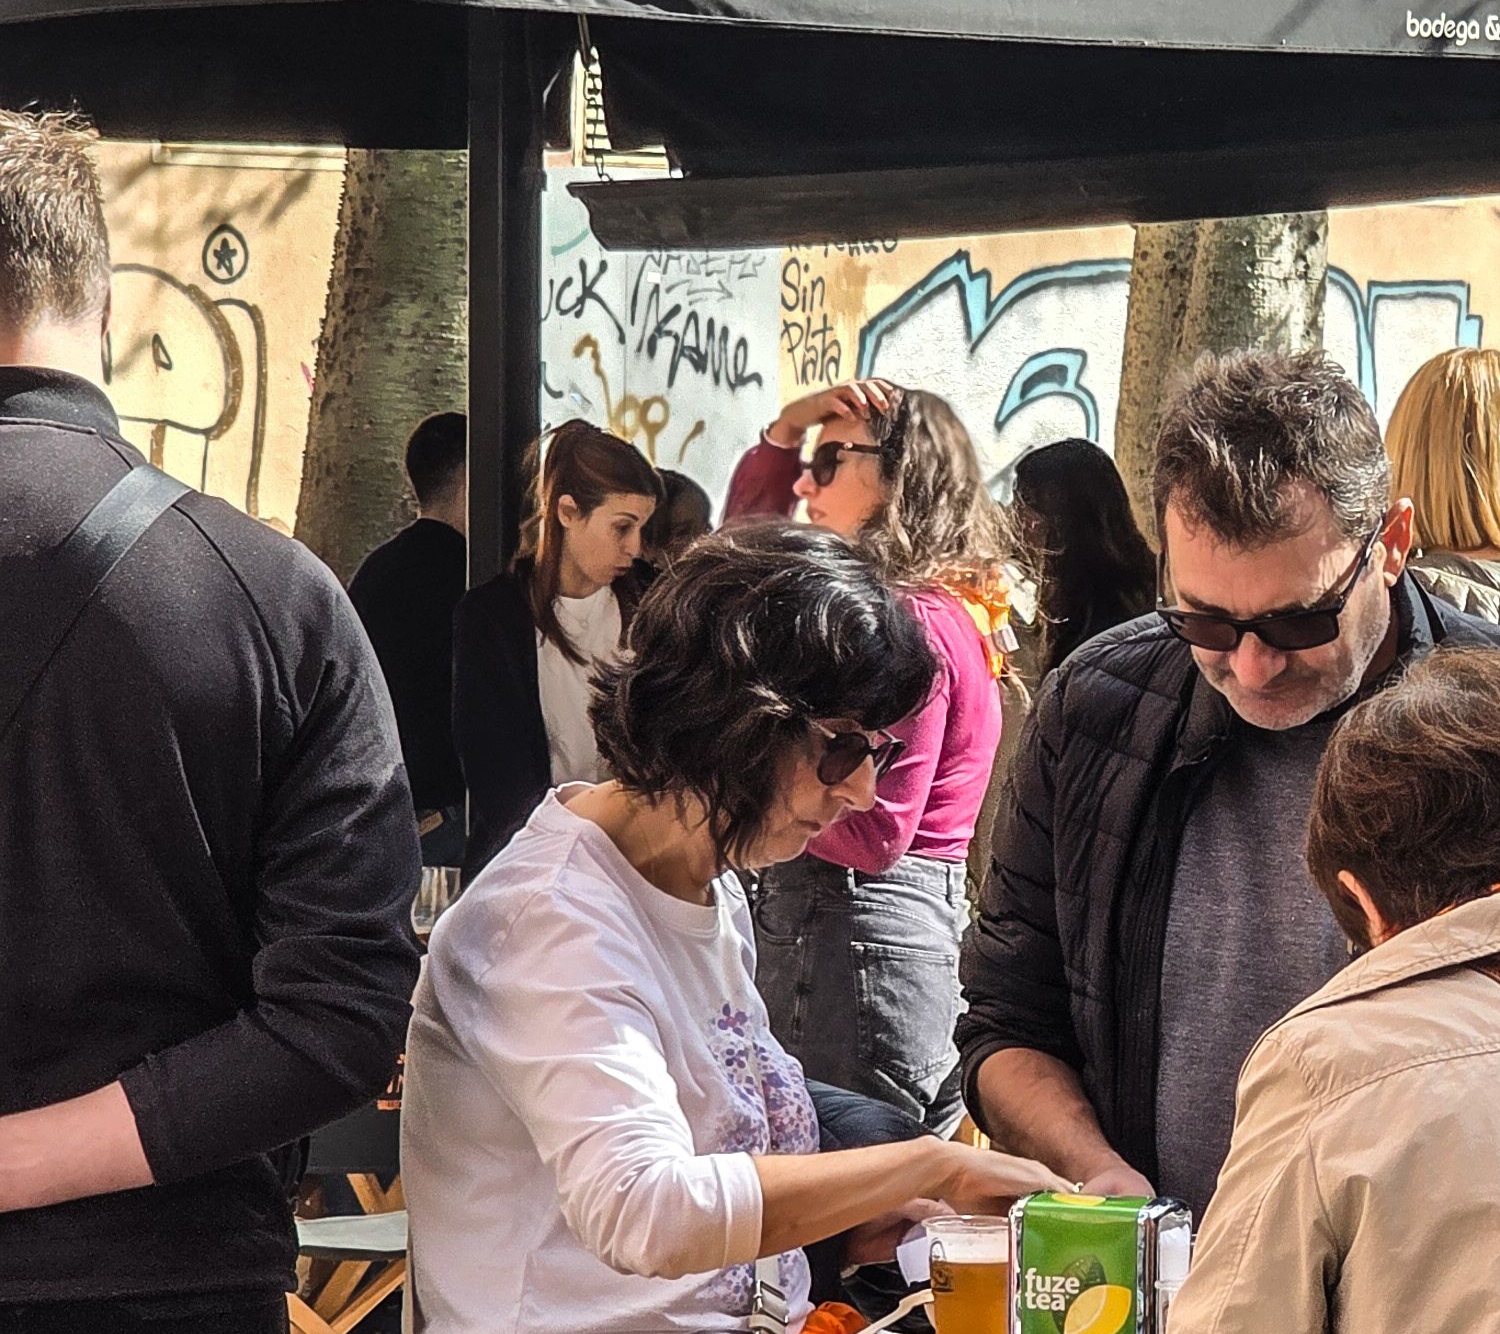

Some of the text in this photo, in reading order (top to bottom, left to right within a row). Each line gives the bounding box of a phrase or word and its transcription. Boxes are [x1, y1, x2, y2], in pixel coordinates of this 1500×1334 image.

[1406, 10, 1480, 46] bodega
[1485, 15, 1500, 41] &
[1025, 1268, 1080, 1294] fuze
[1025, 1291, 1066, 1312] tea
